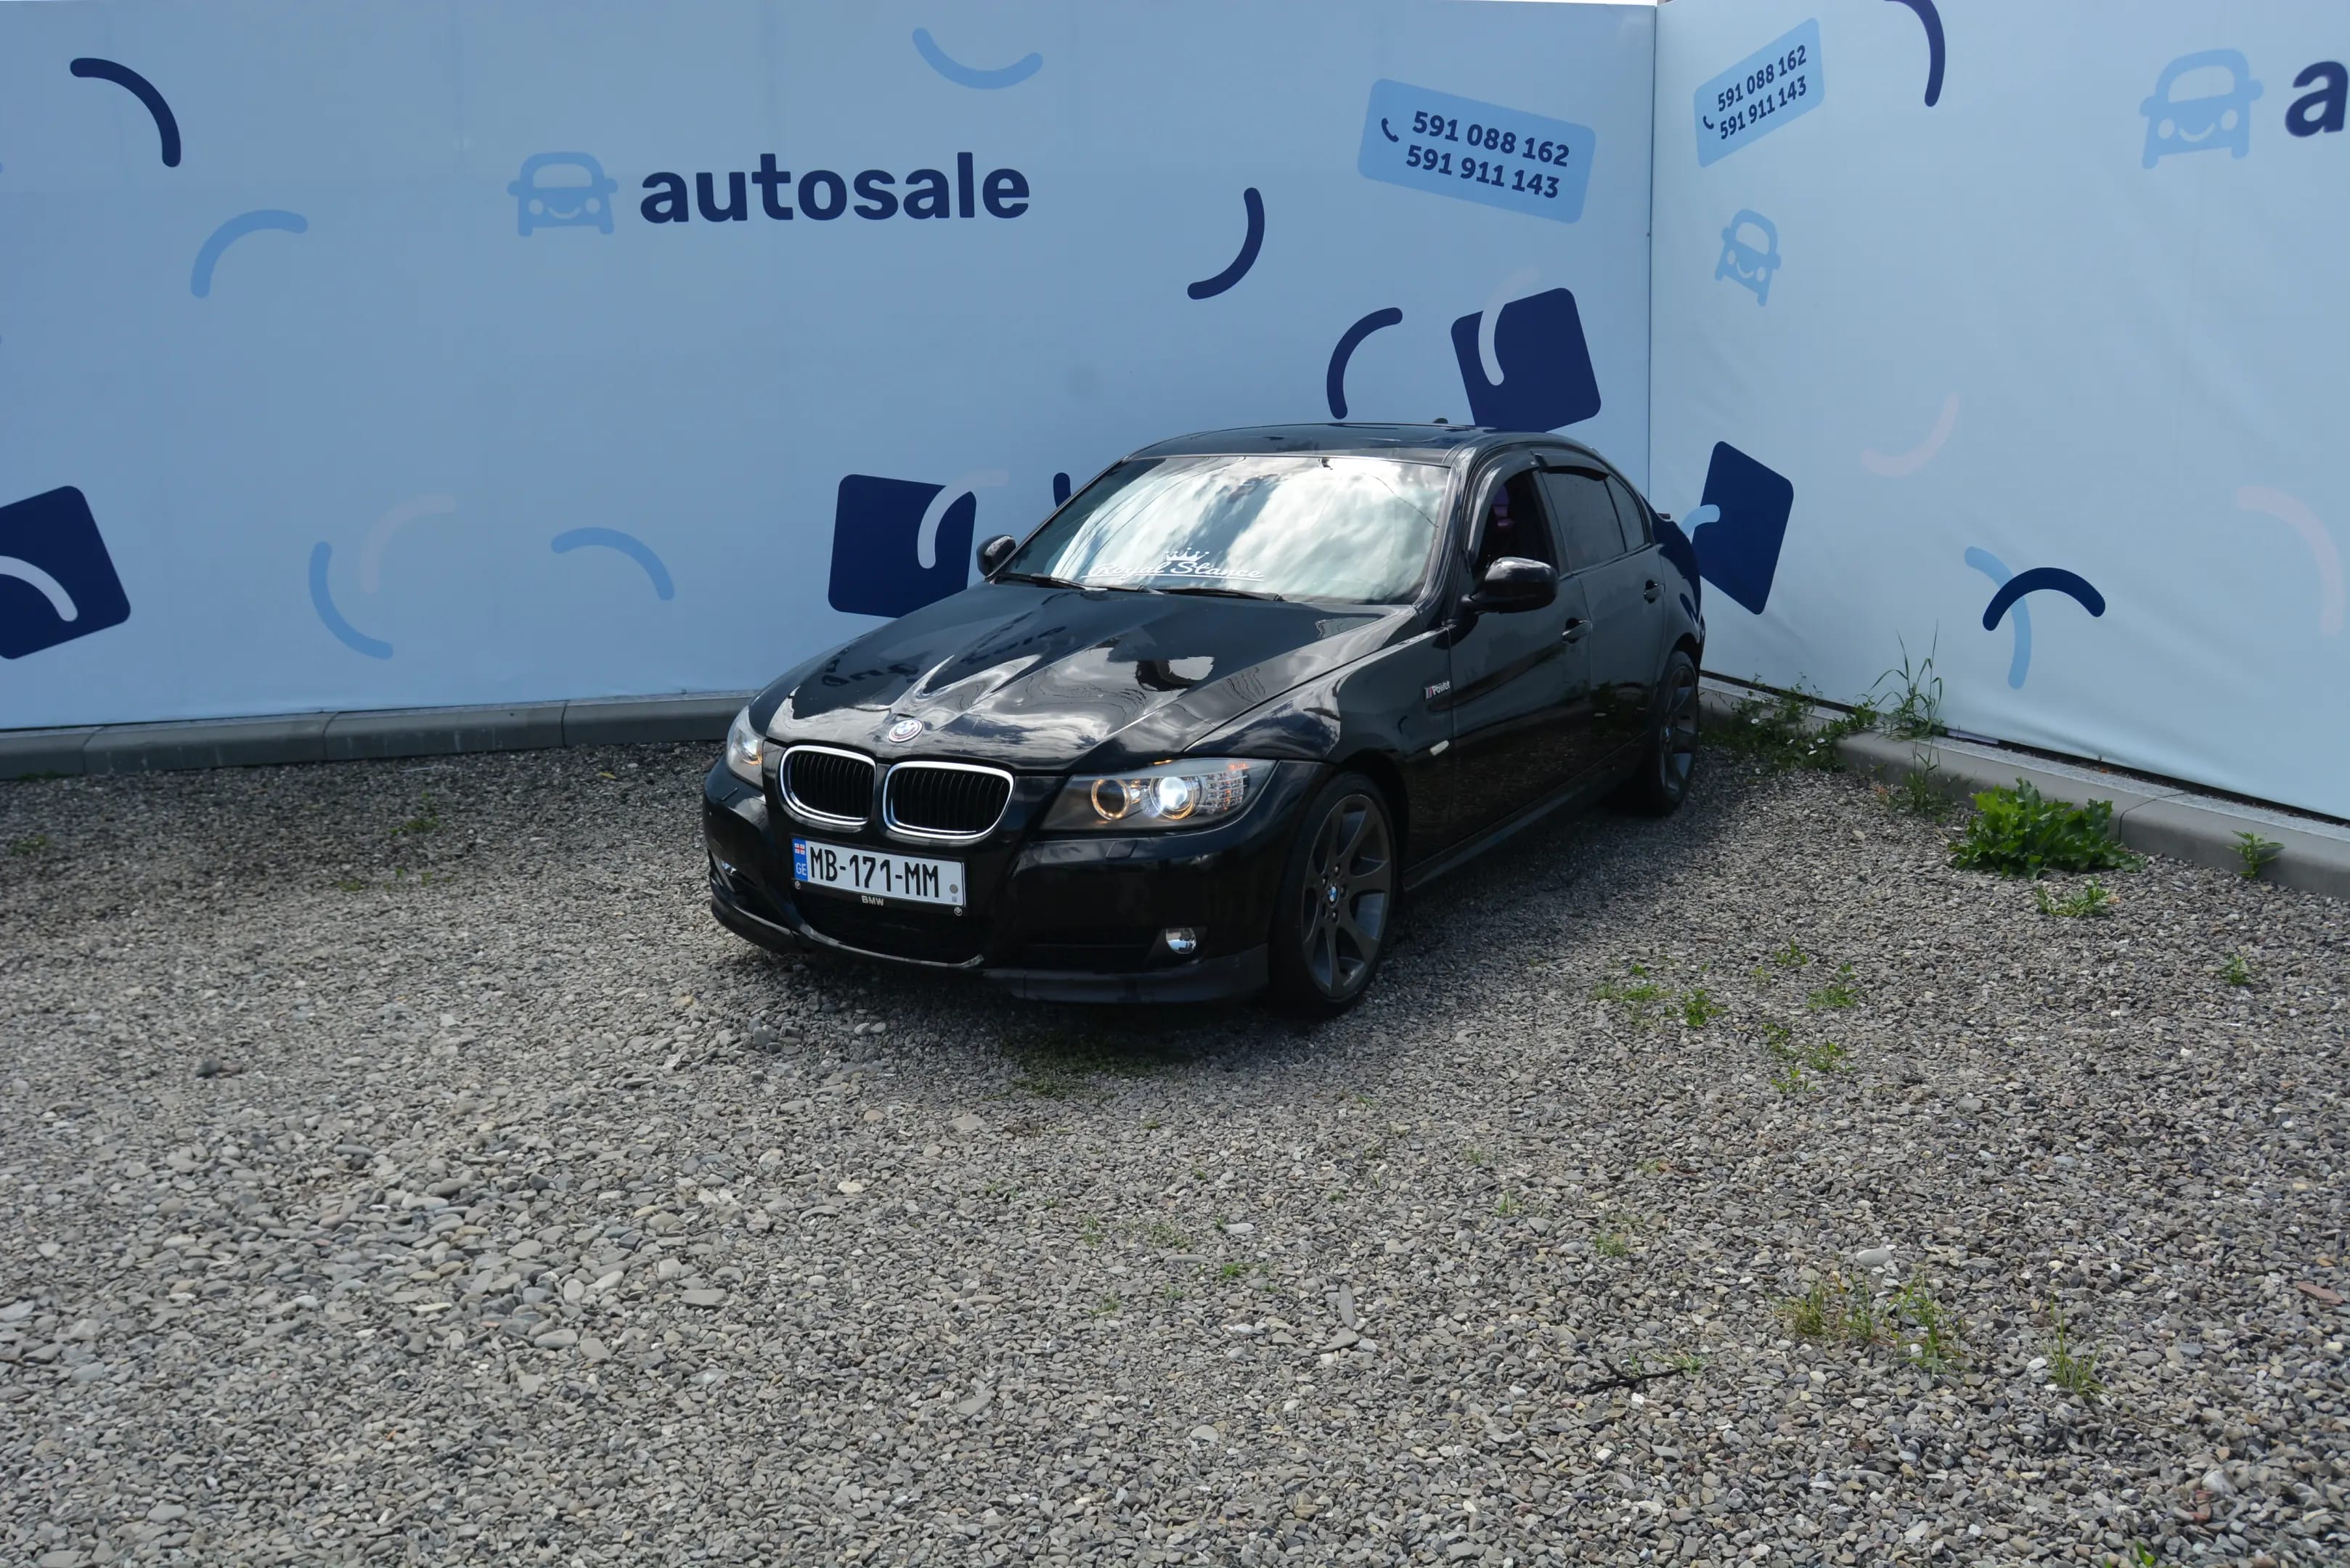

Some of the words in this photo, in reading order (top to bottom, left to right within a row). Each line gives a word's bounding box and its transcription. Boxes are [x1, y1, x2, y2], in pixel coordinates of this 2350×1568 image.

[1718, 82, 1743, 112] 591
[1747, 63, 1774, 94] 088
[1779, 44, 1806, 77] 162
[1720, 110, 1745, 140] 591
[1749, 94, 1775, 124] 911
[1779, 75, 1806, 107] 143
[1412, 110, 1458, 142] 591
[1466, 123, 1516, 154] 088
[1522, 137, 1570, 167] 162
[640, 152, 1030, 224] autosale
[1405, 144, 1452, 175] 591
[1460, 157, 1504, 187] 911
[1511, 169, 1559, 199] 143
[1087, 561, 1172, 581] Royal
[1170, 561, 1265, 579] Stance
[796, 862, 807, 876] GE
[809, 846, 939, 898] MB-171-MM
[861, 895, 884, 906] BMW
